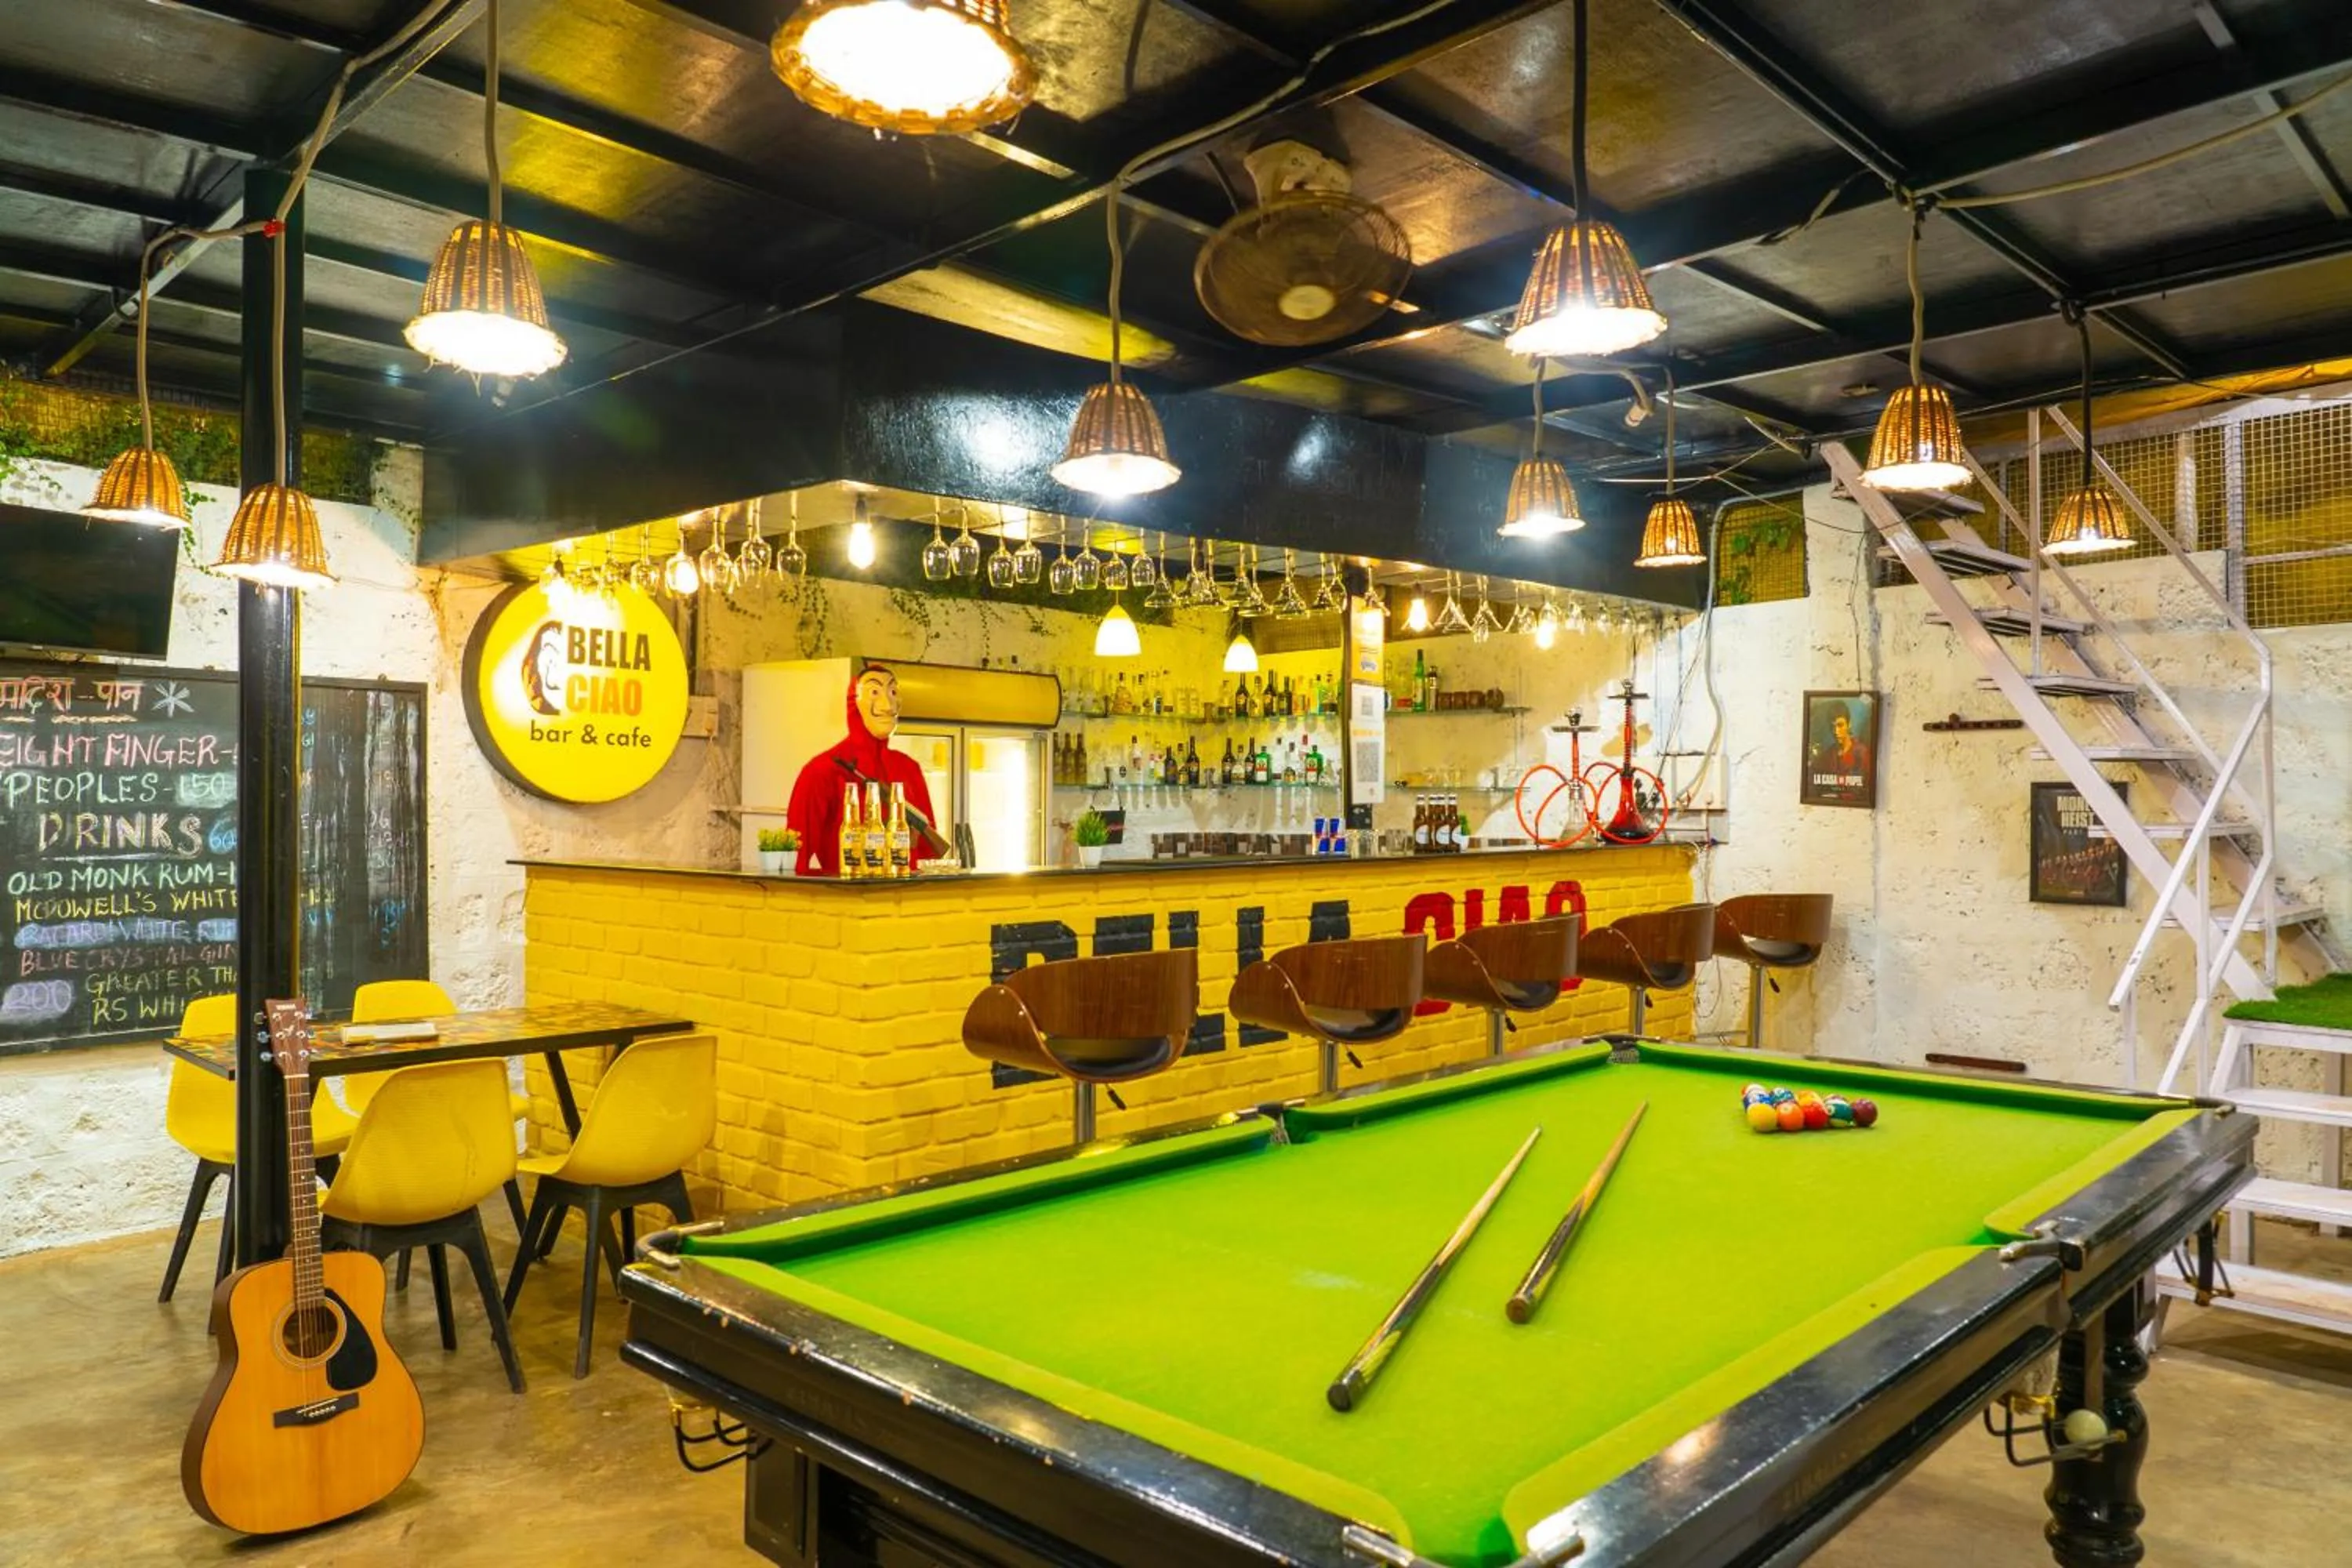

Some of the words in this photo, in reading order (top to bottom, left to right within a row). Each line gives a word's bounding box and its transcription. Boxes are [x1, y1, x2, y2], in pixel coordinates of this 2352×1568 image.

[567, 625, 652, 672] BELLA
[565, 673, 643, 717] CIAO
[530, 719, 572, 743] bar
[580, 724, 598, 745] &
[605, 726, 652, 748] cafe
[38, 811, 202, 856] DRINKS
[8, 872, 63, 895] OLD
[70, 863, 150, 892] MONK
[21, 949, 78, 977] BLUE
[85, 945, 194, 970] CRYSTAL
[85, 967, 202, 997] GREATER
[93, 996, 129, 1025] RS
